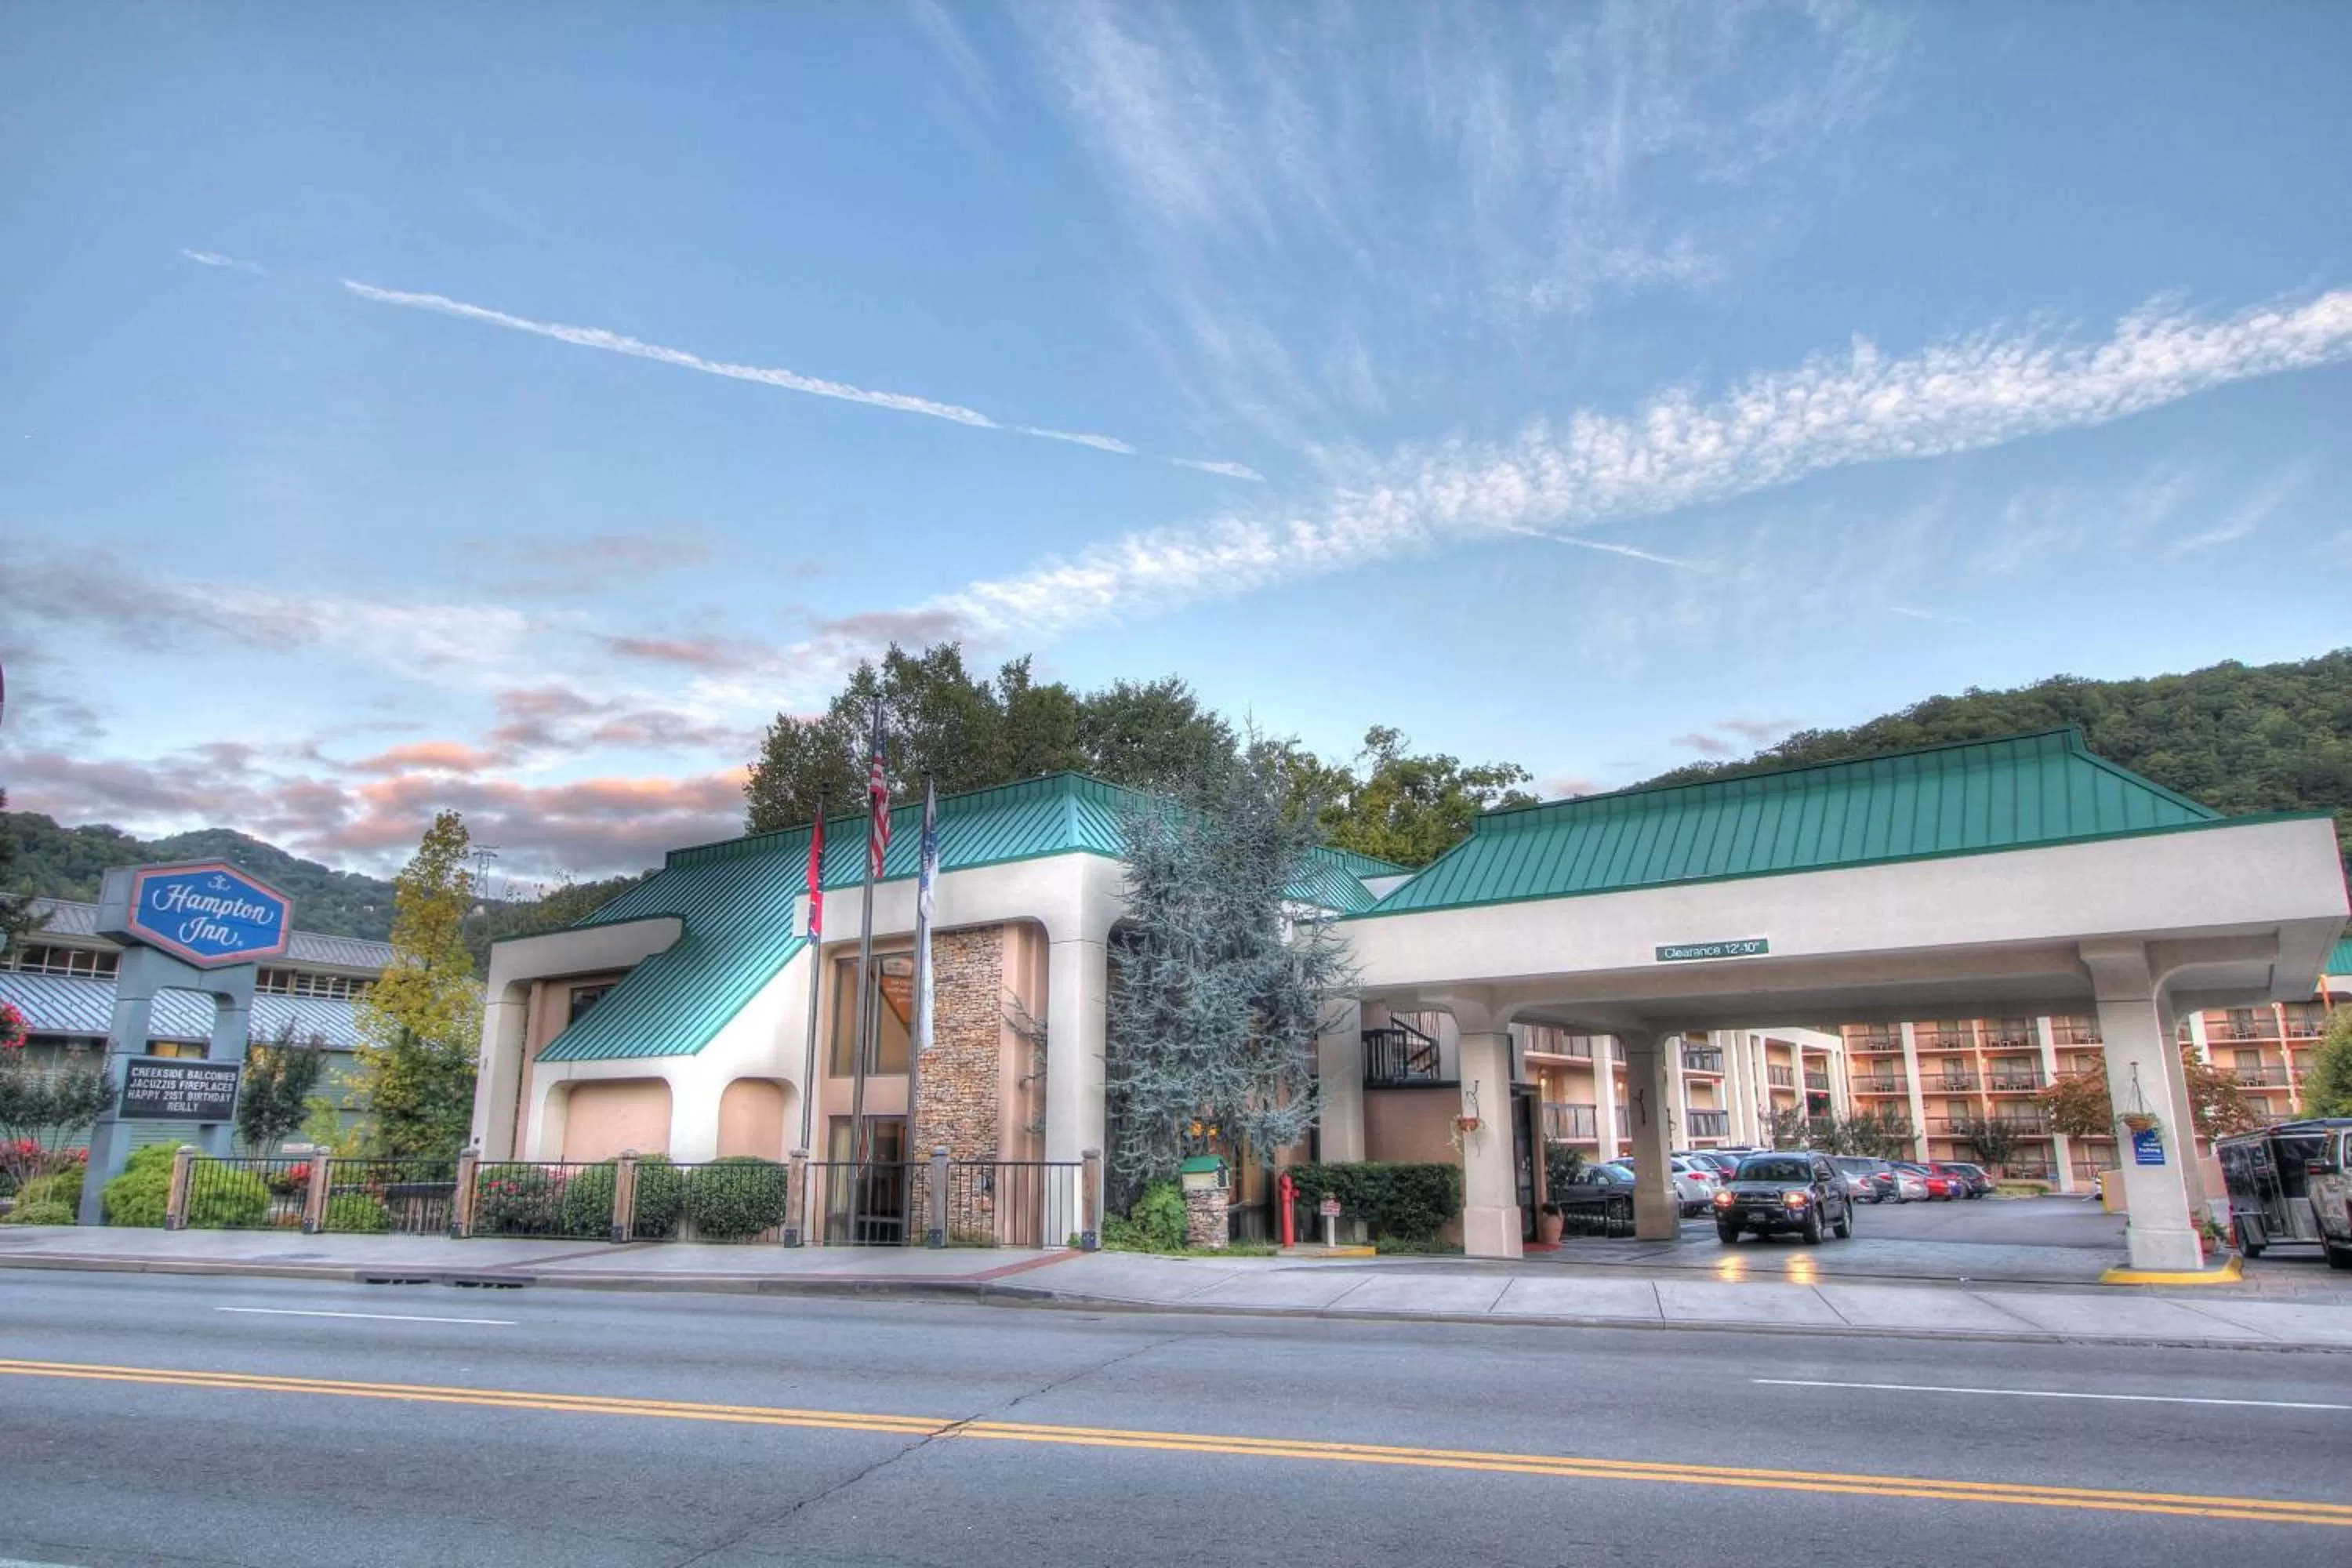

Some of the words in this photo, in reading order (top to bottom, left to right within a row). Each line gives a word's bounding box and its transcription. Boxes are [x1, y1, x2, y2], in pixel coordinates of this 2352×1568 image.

[153, 884, 274, 925] Hampton
[179, 916, 238, 945] Inn
[1664, 946, 1720, 959] Clearance
[132, 1067, 184, 1080] CREEKSIDE
[187, 1069, 236, 1081] BALCONIES
[129, 1078, 176, 1090] JACUZZIS
[179, 1080, 234, 1092] FIREPLACES
[128, 1089, 161, 1100] HAPPY
[162, 1091, 184, 1101] 21ST
[187, 1091, 232, 1102] BIRTHDAY
